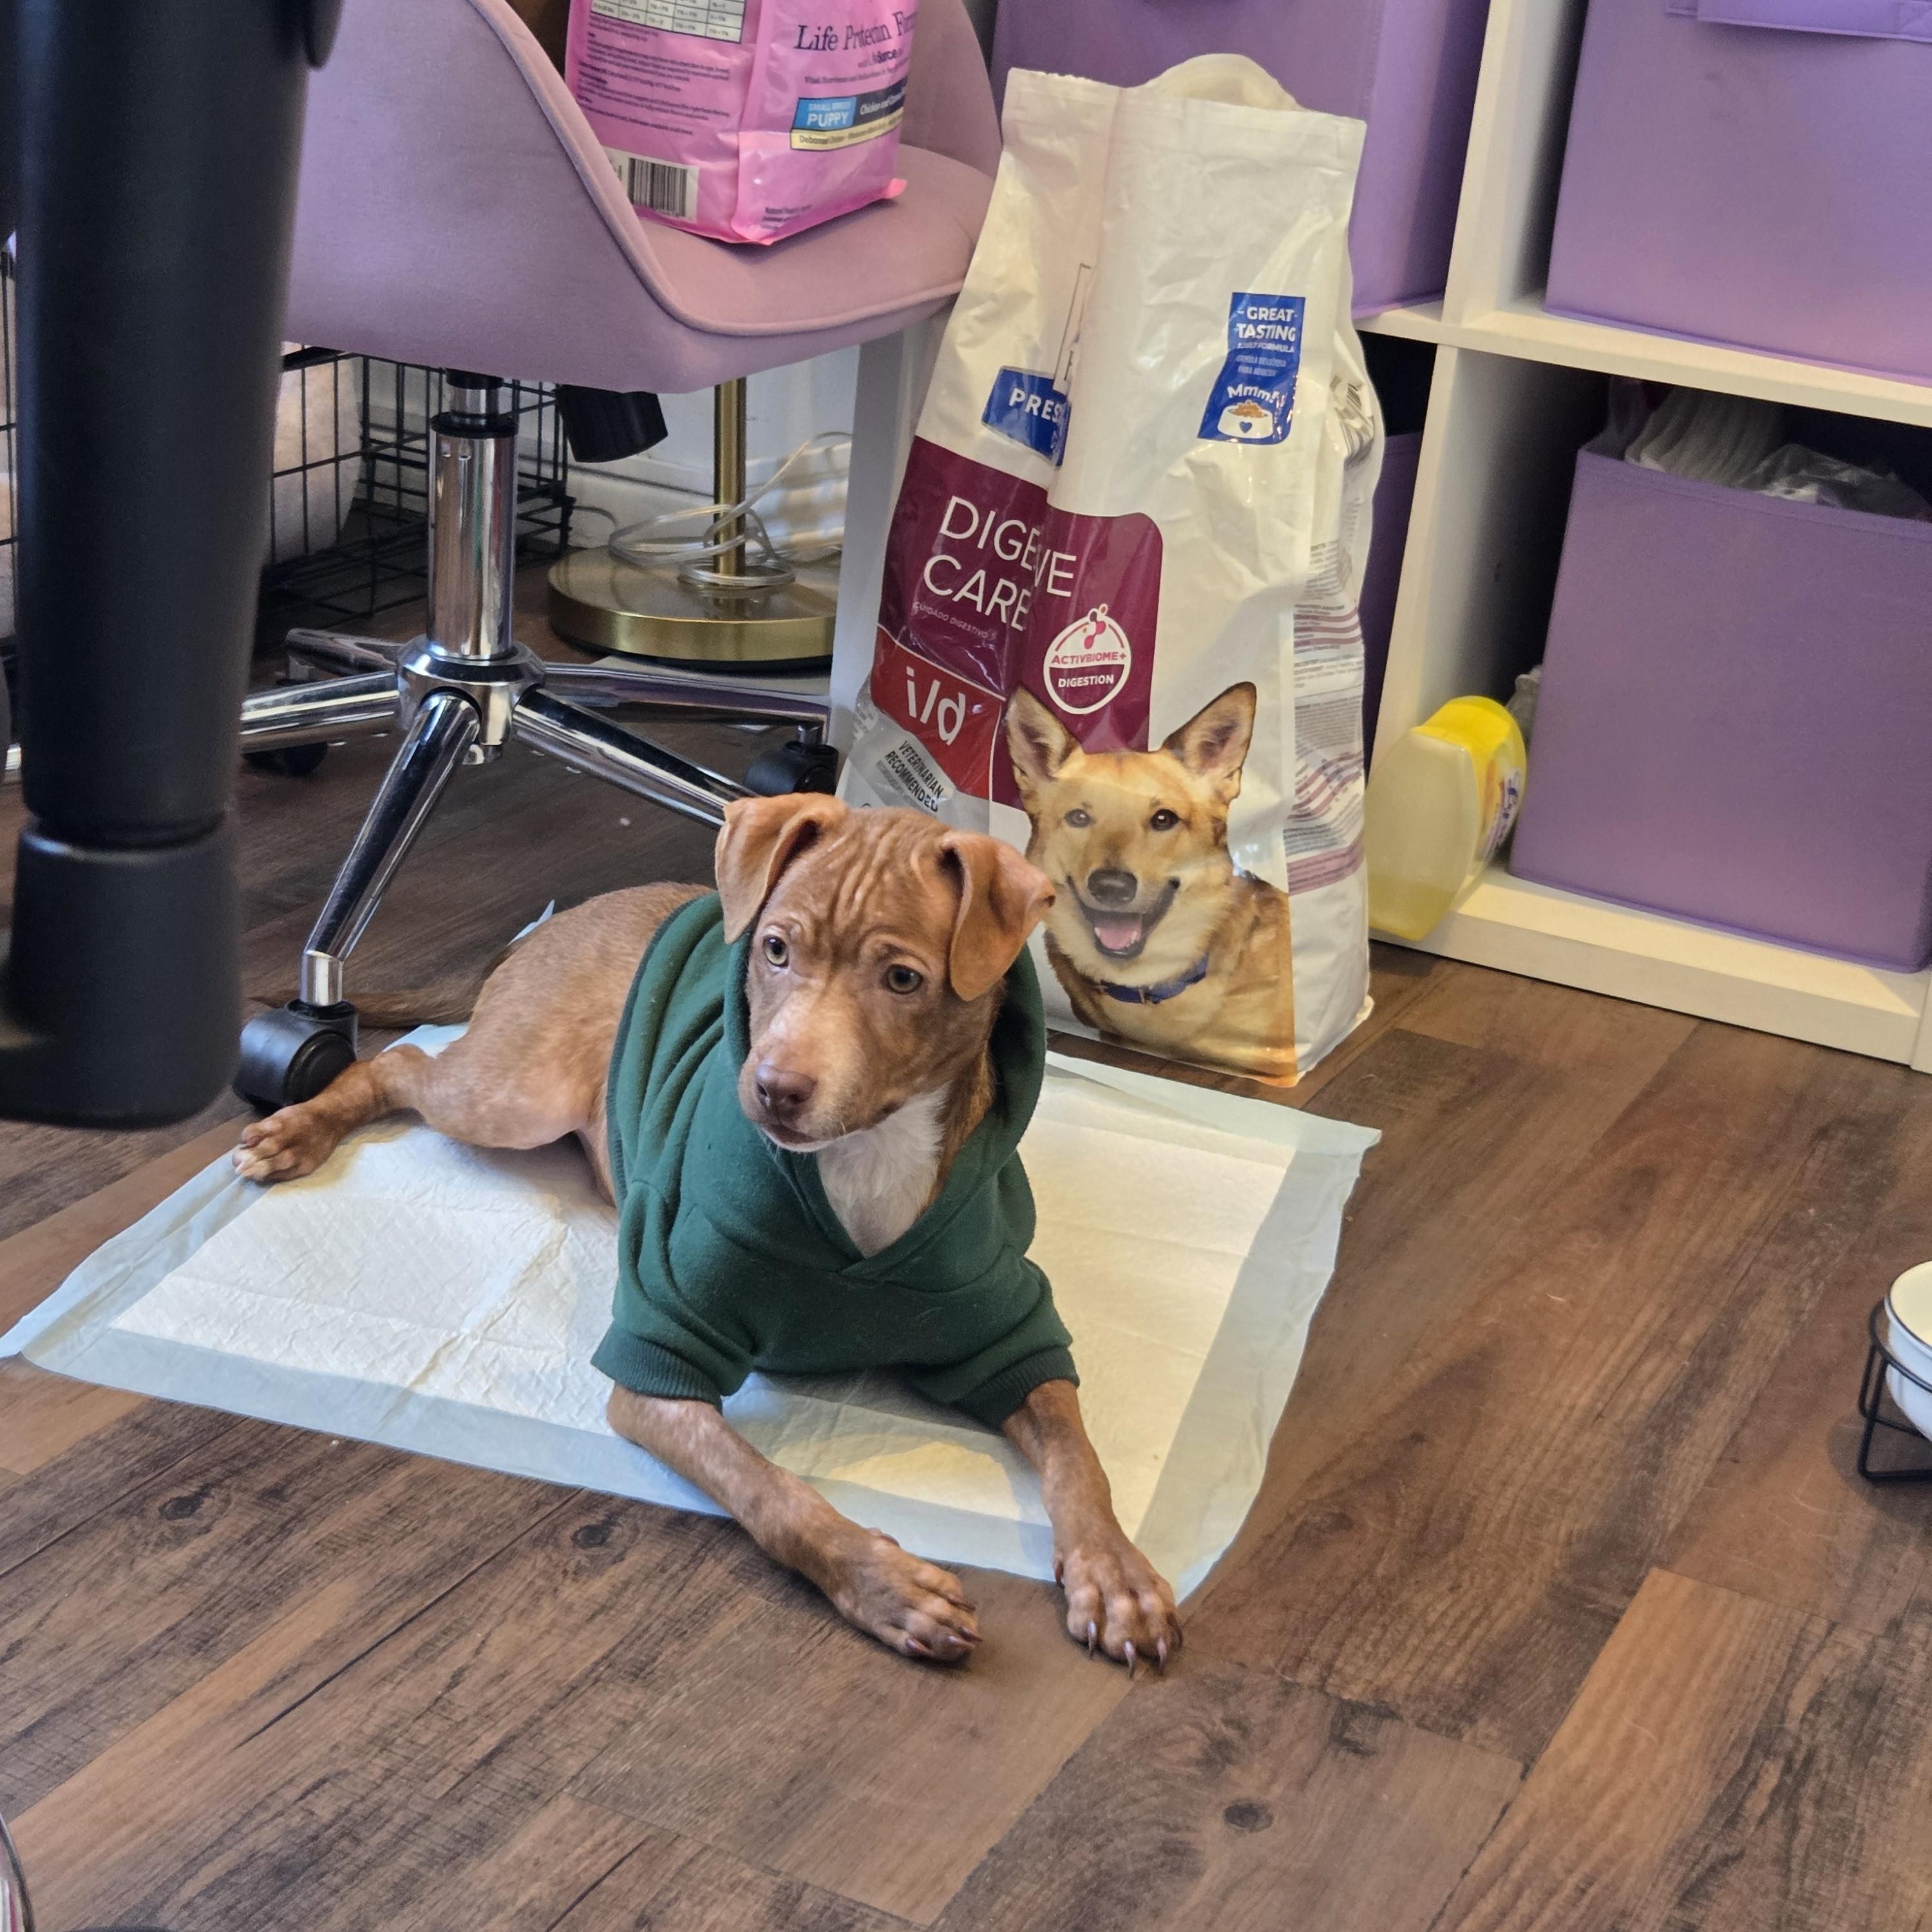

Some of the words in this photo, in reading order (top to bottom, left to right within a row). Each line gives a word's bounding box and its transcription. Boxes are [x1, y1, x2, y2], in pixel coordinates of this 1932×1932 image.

[794, 24, 838, 51] Life
[806, 111, 849, 128] PUPPY
[1247, 307, 1294, 321] GREAT
[1236, 323, 1296, 342] TASTING
[923, 554, 1032, 632] CARE
[949, 617, 989, 639] DIGESTIVO
[1058, 674, 1115, 688] DIGESTION
[906, 666, 966, 746] i/d
[884, 751, 938, 813] RECOMMENDED
[898, 741, 944, 799] VETERINARIAN
